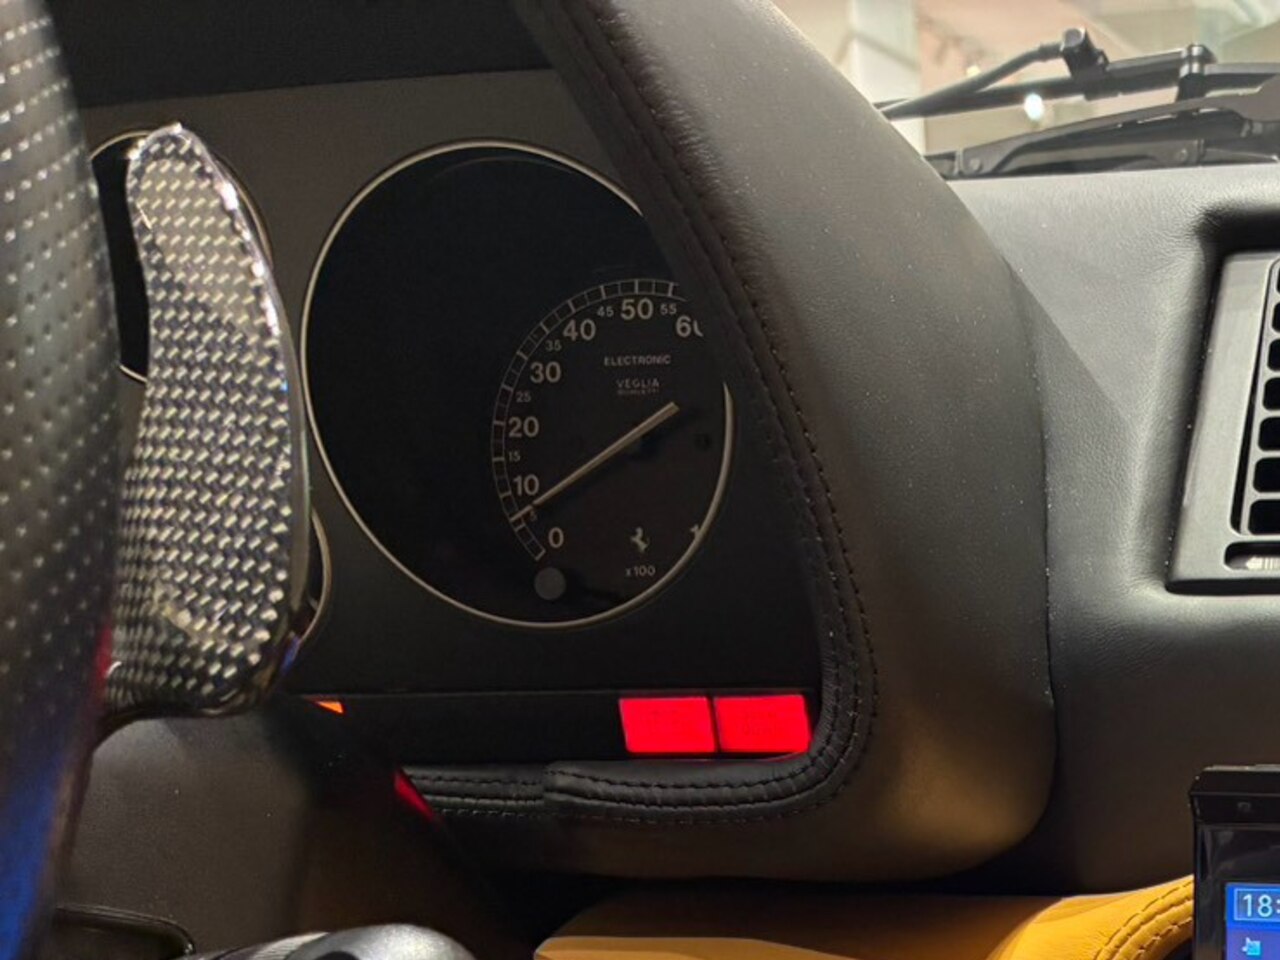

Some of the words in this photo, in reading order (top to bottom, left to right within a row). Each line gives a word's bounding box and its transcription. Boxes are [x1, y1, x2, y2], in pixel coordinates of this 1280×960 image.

[620, 298, 653, 320] 50
[660, 303, 677, 315] 55
[562, 318, 596, 341] 40
[604, 353, 671, 367] ELECTRONIC
[530, 361, 561, 383] 30
[616, 377, 660, 389] VEGLIA
[508, 416, 539, 438] 20
[513, 473, 540, 496] 10
[548, 527, 564, 549] 0
